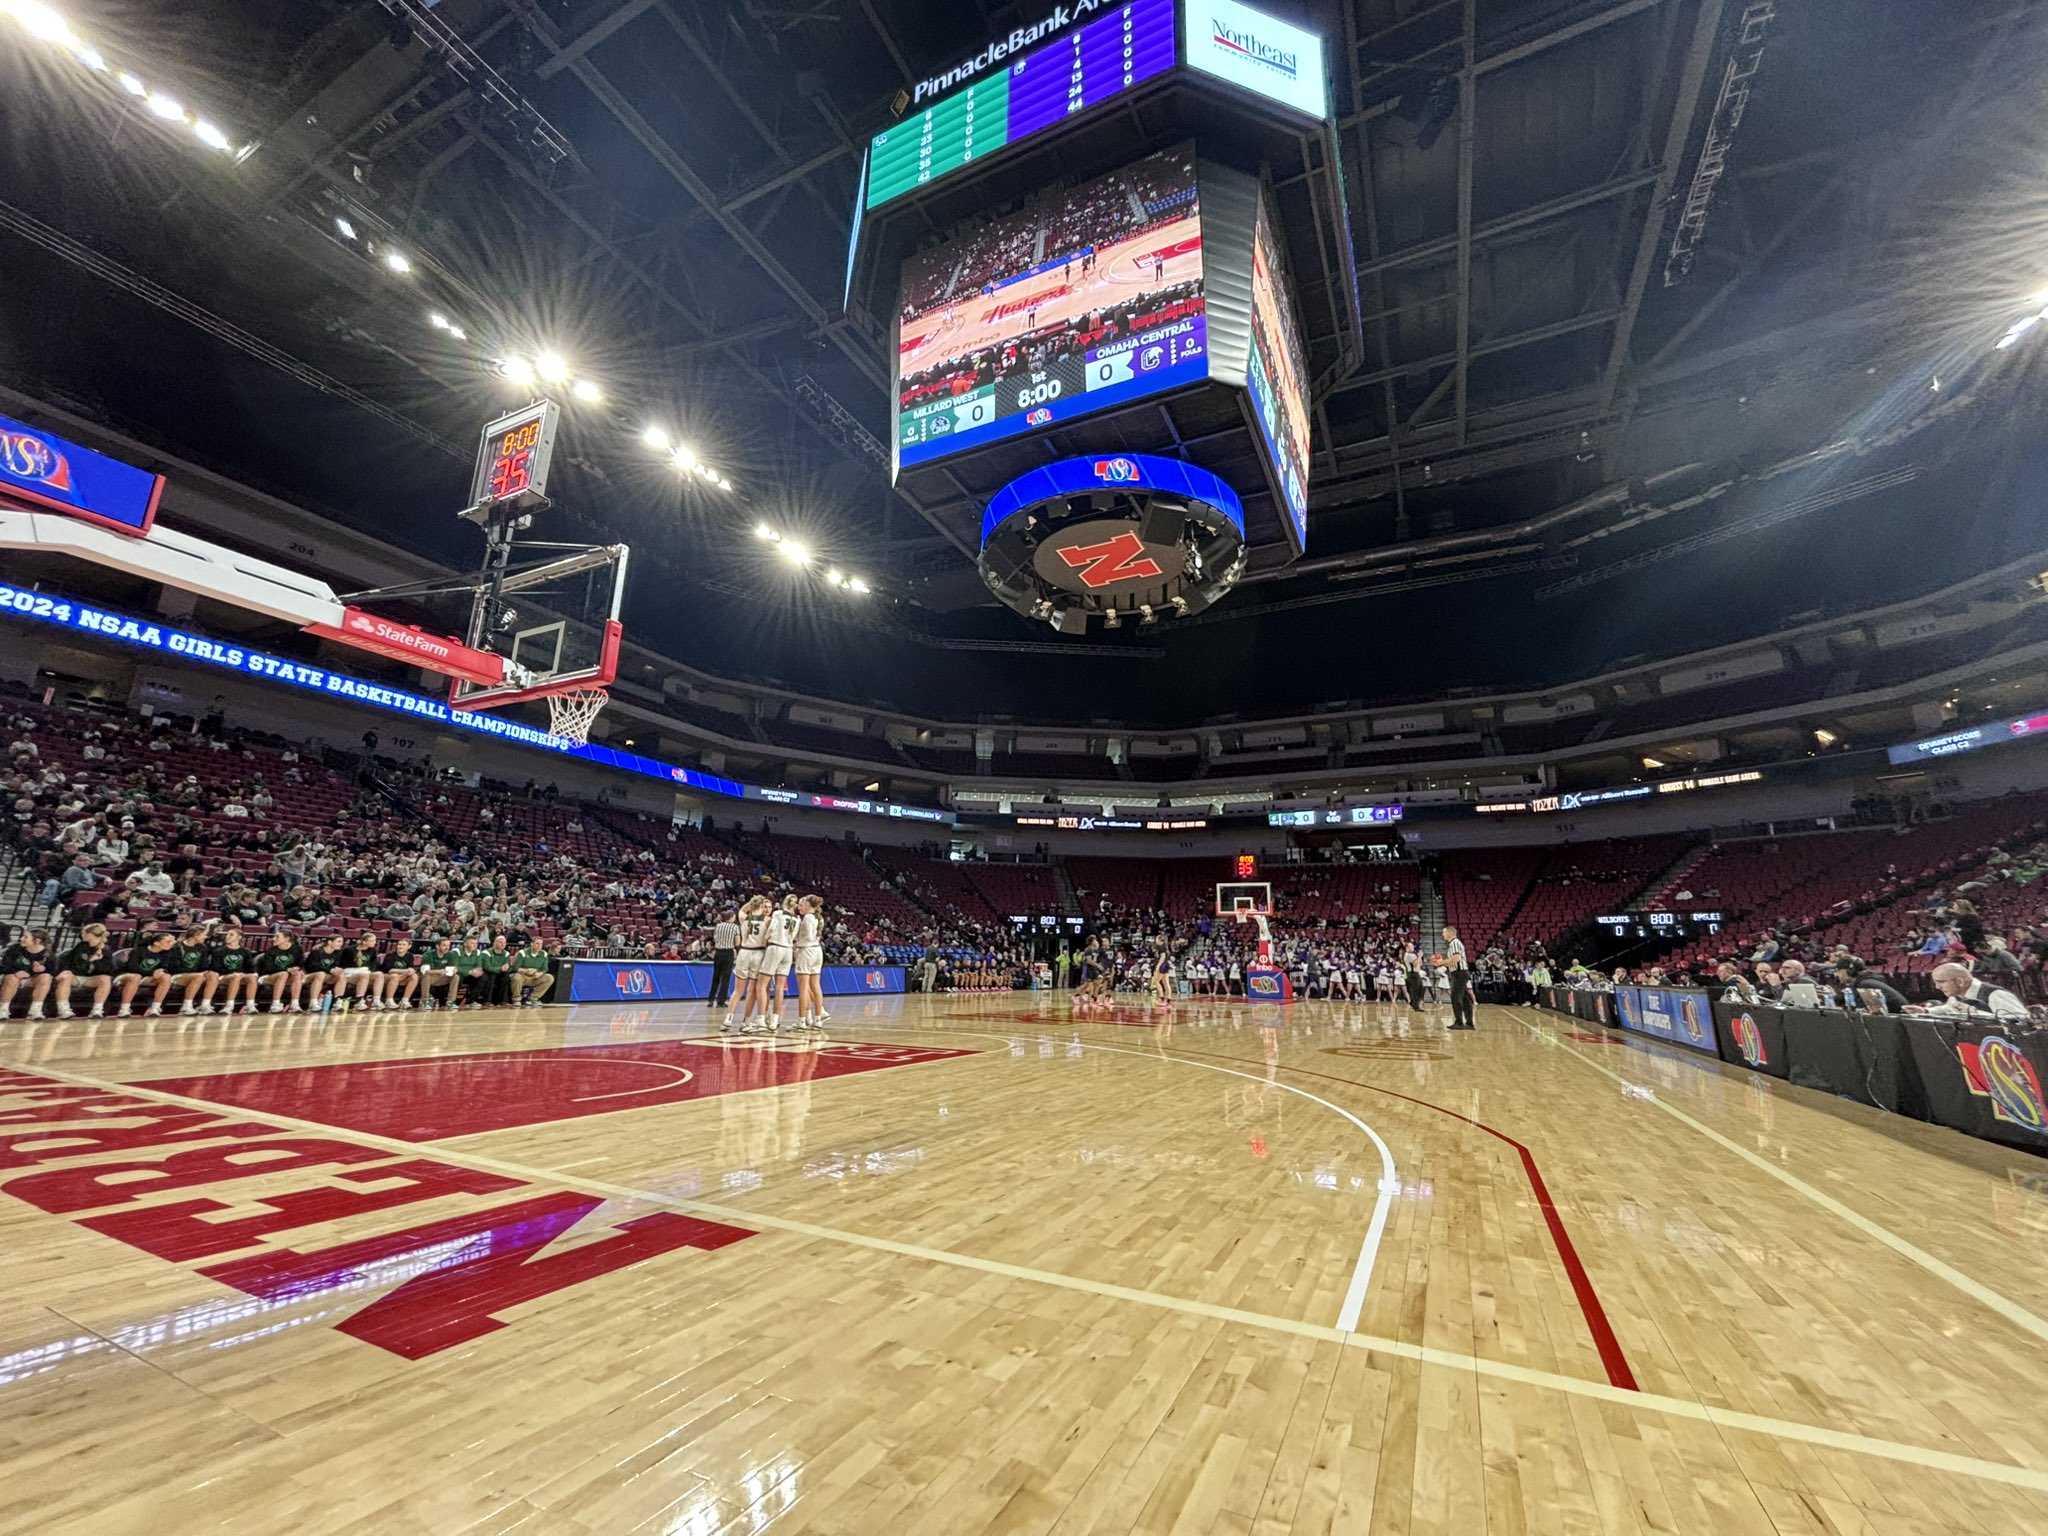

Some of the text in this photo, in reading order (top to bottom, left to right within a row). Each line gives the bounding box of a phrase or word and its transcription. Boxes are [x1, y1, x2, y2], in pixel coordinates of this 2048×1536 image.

[1123, 20, 1132, 31] 0
[1123, 33, 1132, 45] 0
[1211, 17, 1297, 69] Northeast
[1123, 47, 1132, 58] 0
[1123, 60, 1132, 71] 0
[1123, 74, 1132, 85] 0
[966, 101, 974, 112] 0
[966, 113, 974, 124] 0
[965, 125, 973, 136] 0
[964, 138, 973, 149] 0
[1096, 321, 1194, 359] OMAHA CENTRAL
[1186, 337, 1195, 348] 0
[1031, 371, 1047, 384] 1st
[1099, 363, 1113, 381] 0
[1018, 379, 1062, 408] 8:00
[913, 390, 980, 420] MILLARD WEST
[972, 405, 983, 422] 0
[502, 422, 540, 456] 8:00
[493, 451, 529, 498] 35
[0, 586, 72, 622] 2024
[78, 609, 162, 647] NSAA
[168, 633, 244, 667] GIRLS
[248, 655, 325, 688] STATE
[327, 676, 448, 720] BASKETBALL
[451, 710, 569, 751] CHAMPIONSHIPS
[1239, 863, 1253, 875] 35
[1650, 913, 1674, 925] 8:00
